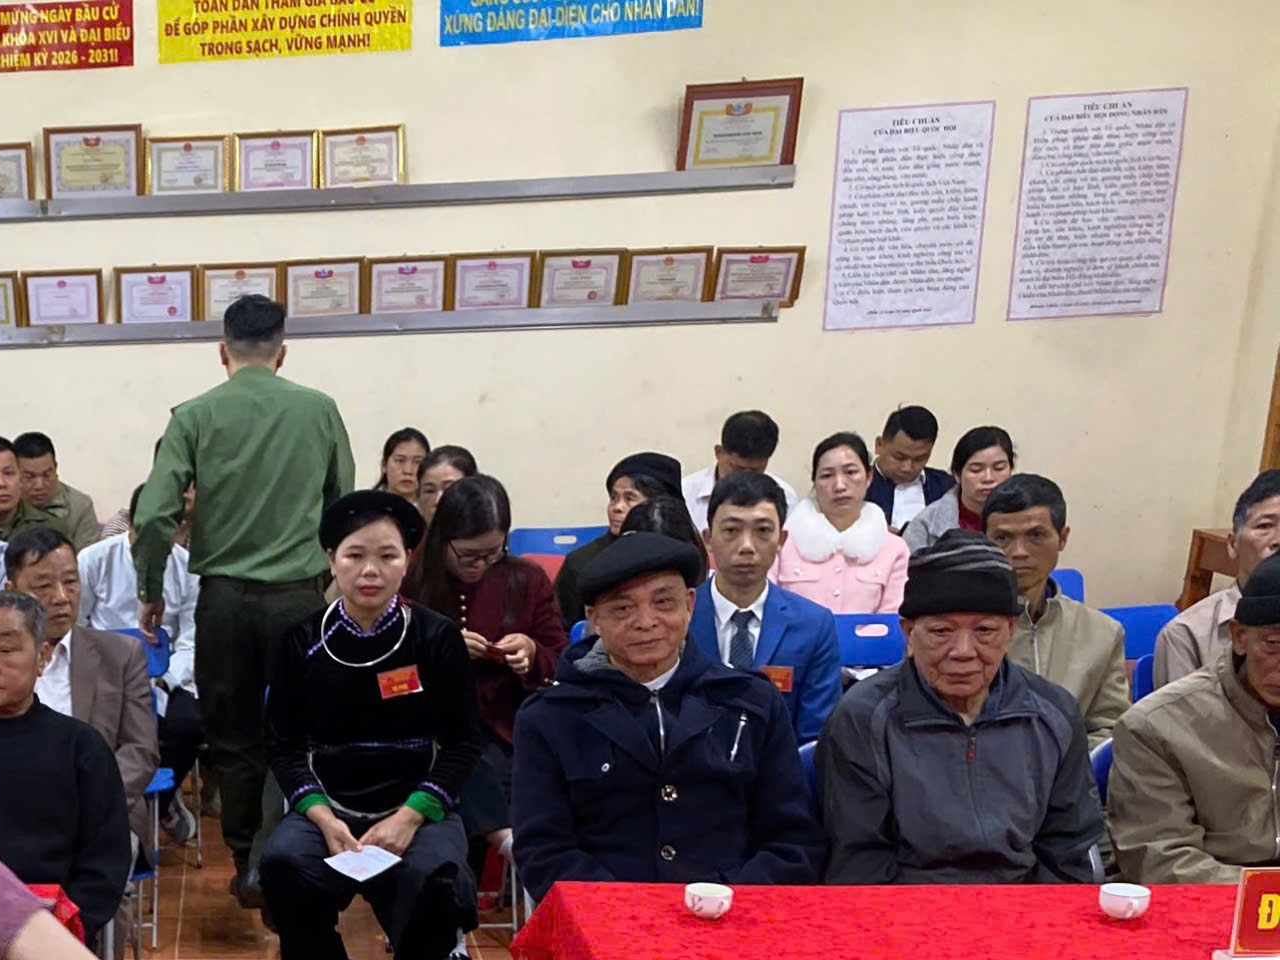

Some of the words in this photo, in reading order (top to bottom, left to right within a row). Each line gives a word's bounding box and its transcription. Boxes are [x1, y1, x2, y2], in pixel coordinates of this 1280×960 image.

[40, 4, 72, 23] NGÀY
[75, 2, 99, 21] BẦU
[102, 1, 120, 20] CỬ
[164, 17, 181, 36] ĐỂ
[183, 18, 209, 35] GÓP
[212, 14, 248, 34] PHẦN
[251, 14, 276, 31] XÂY
[280, 14, 316, 33] DỰNG
[320, 9, 360, 27] CHÍNH
[364, 5, 407, 26] QUYỀN
[444, 10, 483, 34] XỨNG
[591, 2, 620, 23] CHO
[39, 30, 58, 44] XVI
[61, 25, 77, 43] VÀ
[79, 27, 101, 46] ĐẠI
[103, 21, 131, 41] BIỂU
[200, 41, 243, 56] TRONG
[246, 38, 282, 57] SẠCH,
[286, 34, 323, 51] VỮNG
[326, 33, 371, 52] MẠNH!
[33, 48, 48, 65] KỲ
[52, 50, 78, 65] 2026
[88, 48, 119, 63] 2031!
